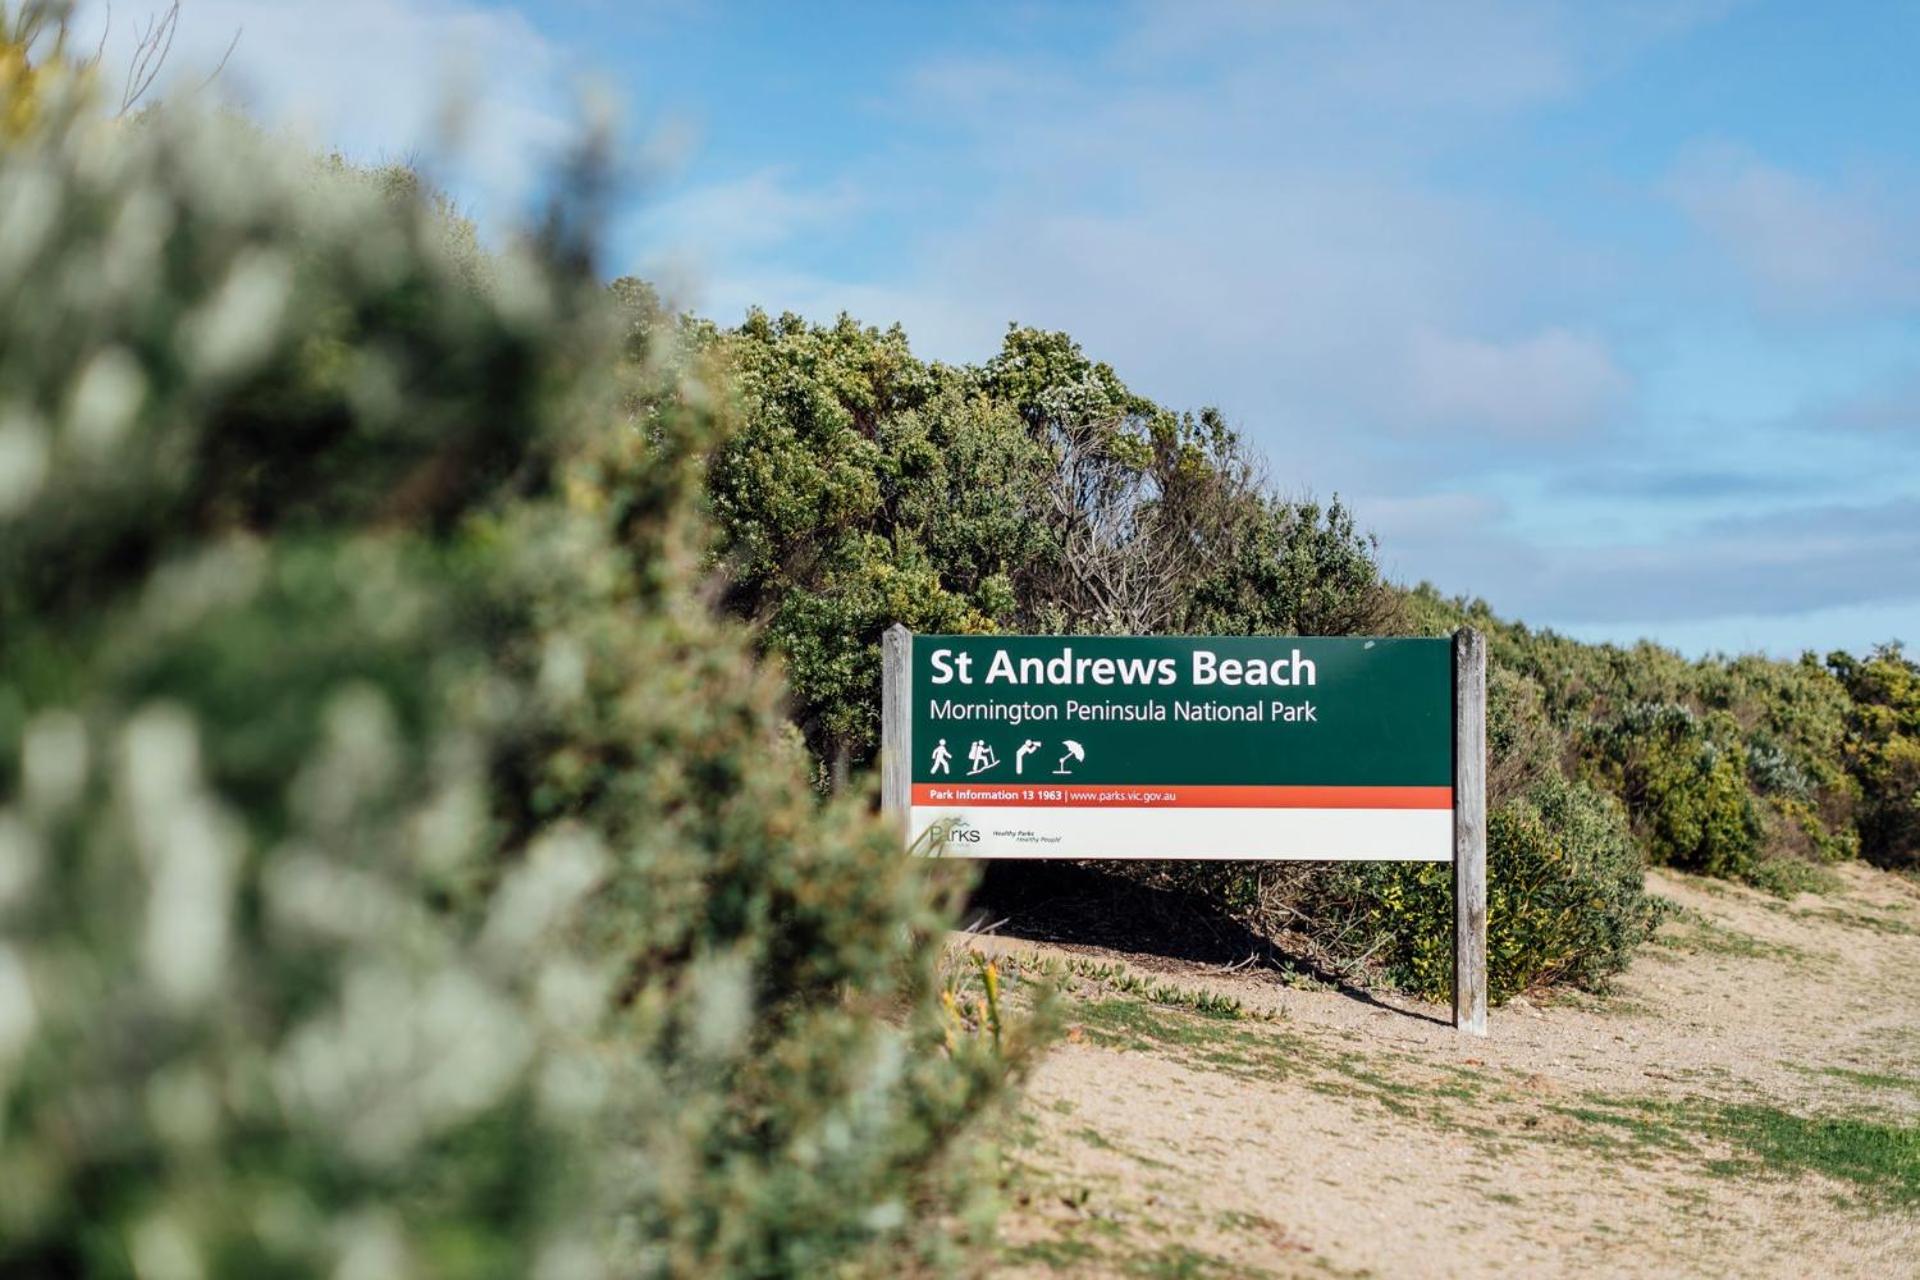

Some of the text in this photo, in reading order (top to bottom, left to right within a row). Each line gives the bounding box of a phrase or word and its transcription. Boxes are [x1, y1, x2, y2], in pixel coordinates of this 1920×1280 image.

[930, 648, 1317, 687] St Andrews Beach
[930, 699, 1317, 725] Mornington Peninsula National Park
[930, 789, 1177, 803] Park Information 13 1963 www.parks.vic.gov.au
